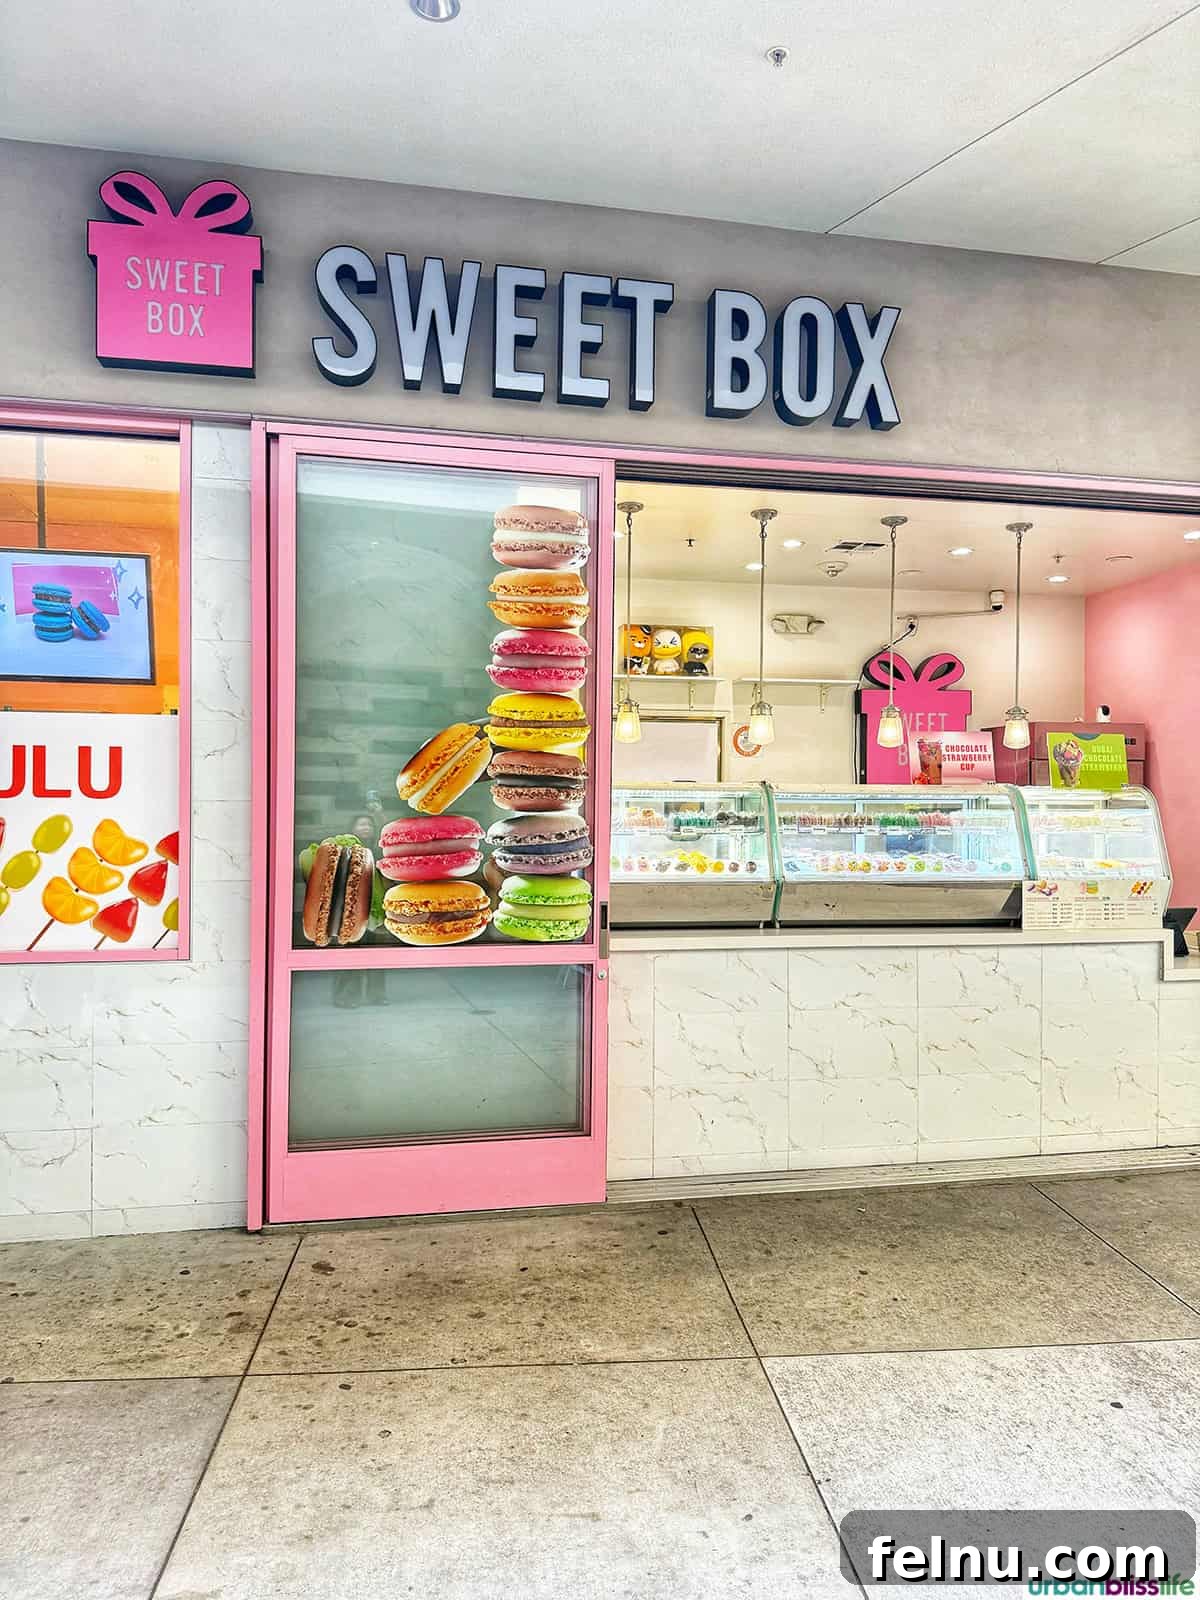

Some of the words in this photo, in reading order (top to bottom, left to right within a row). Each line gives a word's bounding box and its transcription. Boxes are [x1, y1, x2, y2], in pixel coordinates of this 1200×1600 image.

[126, 256, 225, 296] SWEET
[146, 300, 205, 337] BOX
[312, 244, 674, 411] SWEET
[706, 289, 902, 430] BOX
[942, 753, 992, 762] STRAWBERRY
[945, 744, 988, 753] CHOCOLATE
[960, 763, 976, 772] CUP
